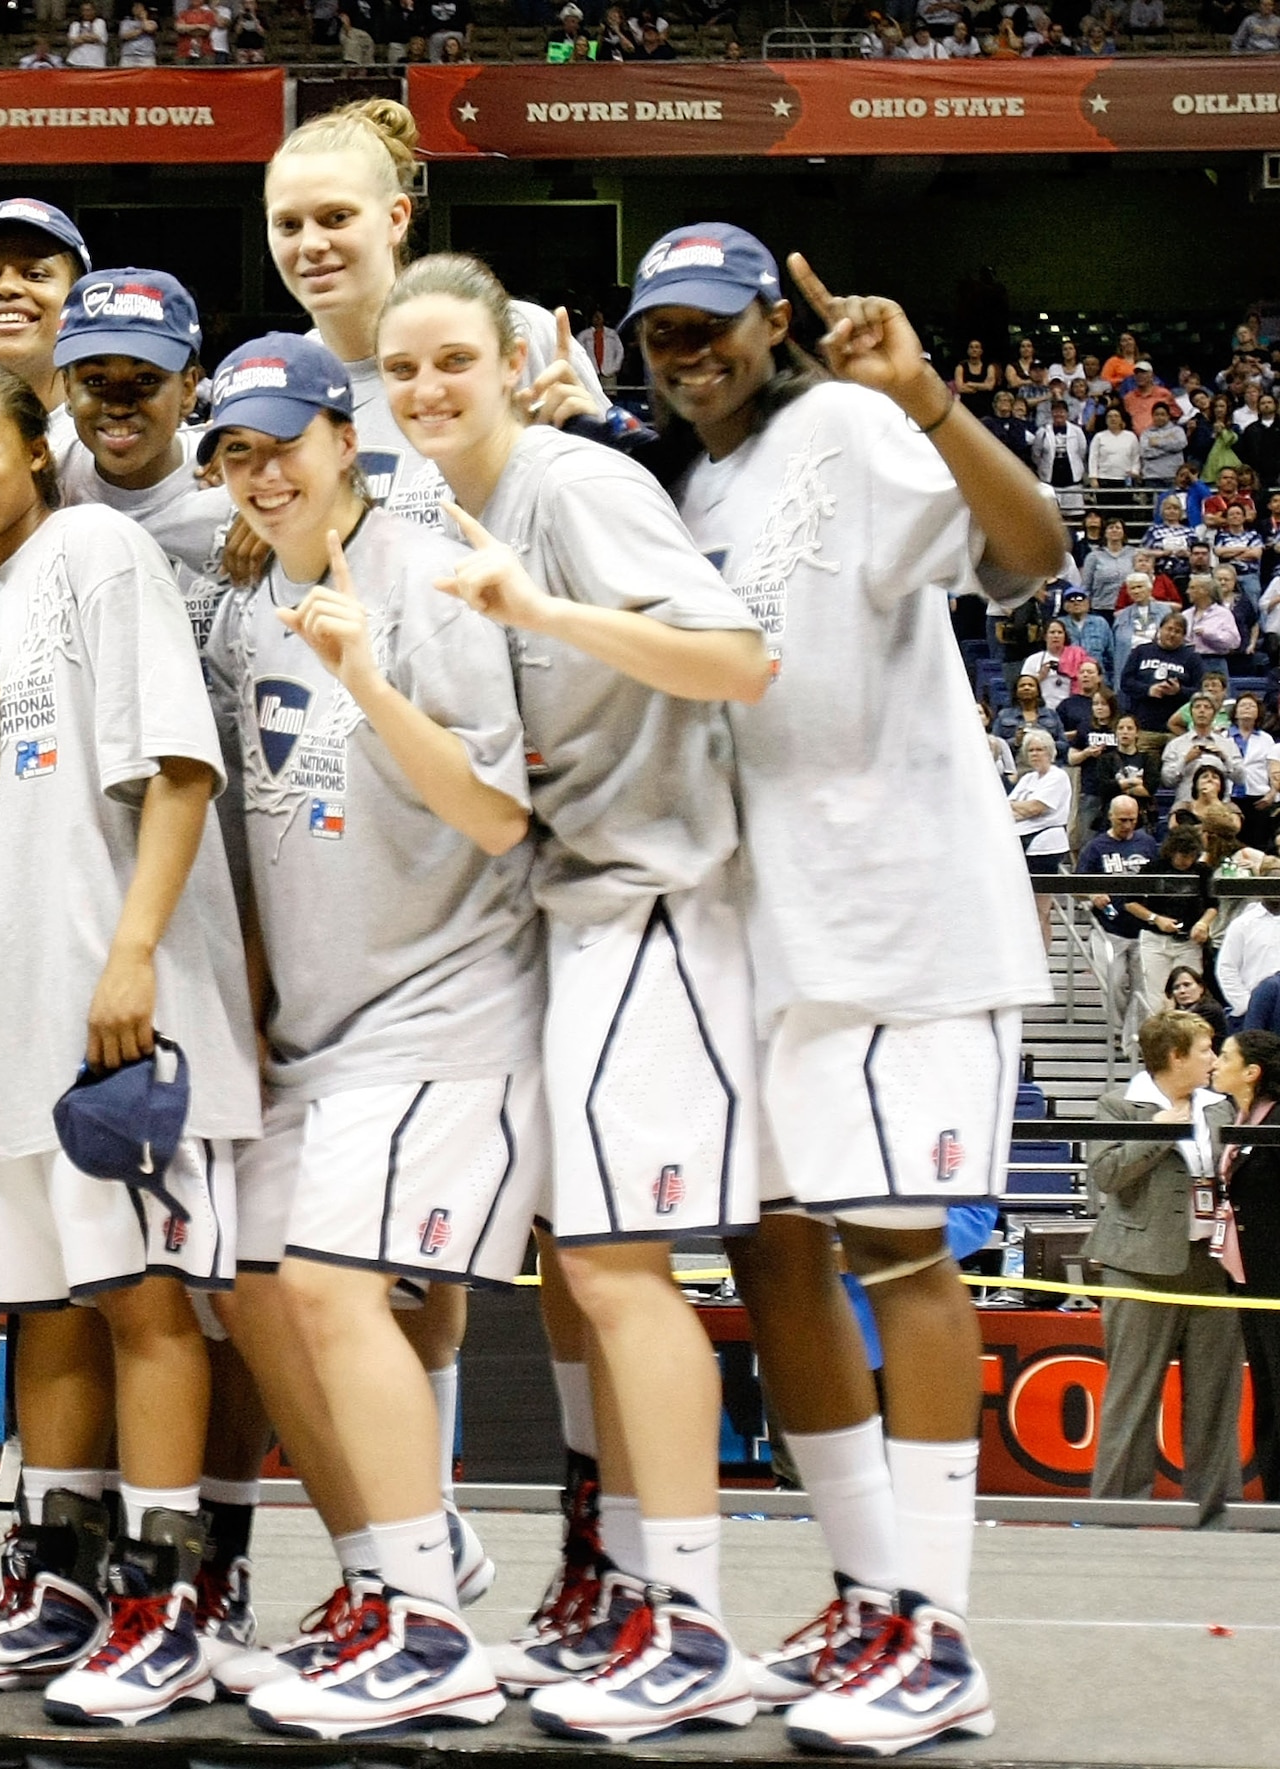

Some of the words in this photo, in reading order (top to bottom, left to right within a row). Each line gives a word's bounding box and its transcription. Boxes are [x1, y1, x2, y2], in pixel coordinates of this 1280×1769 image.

[525, 100, 629, 122] NOTRE
[634, 99, 723, 122] DAME
[849, 97, 928, 119] OHIO
[933, 95, 1025, 118] STATE
[1171, 93, 1280, 115] OKLAH
[134, 105, 215, 127] IOWA
[2, 680, 24, 697] 2010
[26, 673, 54, 690] NCAA
[0, 692, 56, 721] ATIONAL
[260, 696, 305, 734] UConn
[1, 708, 56, 738] MPIONS
[299, 754, 345, 775] NATIONAL
[289, 769, 346, 792] CHAMPIONS
